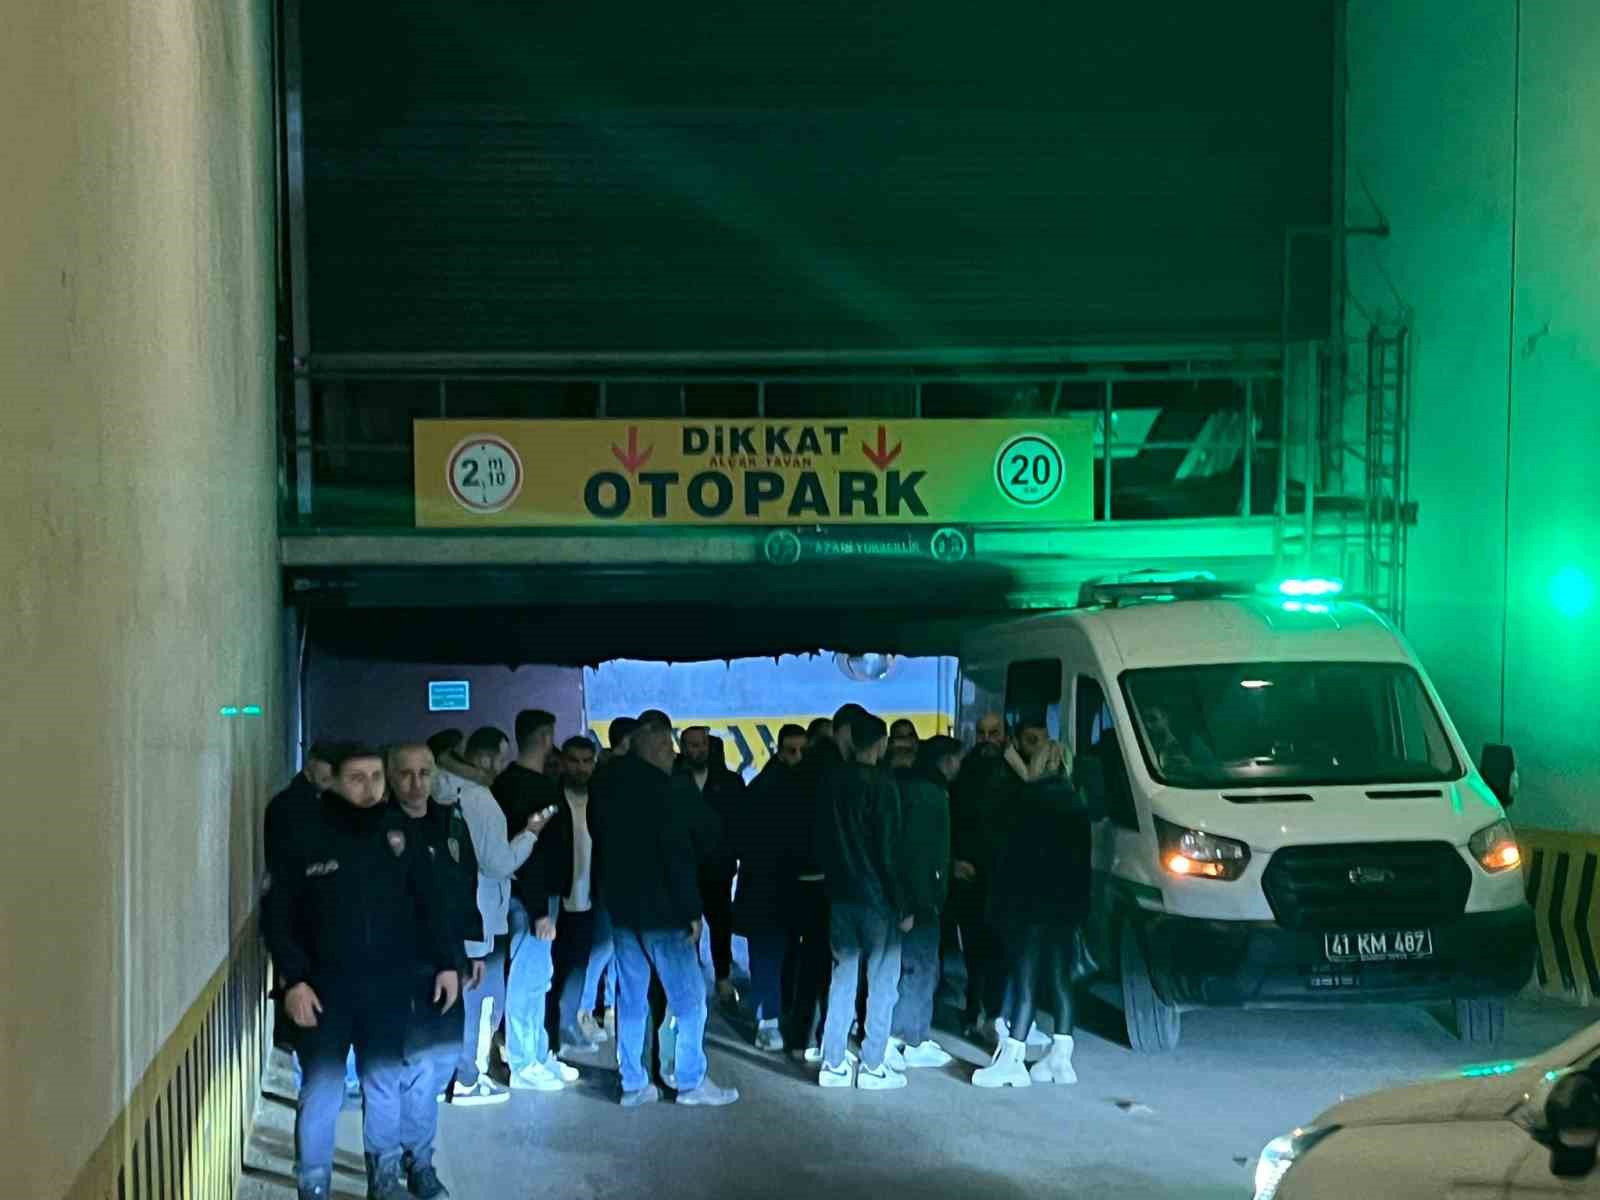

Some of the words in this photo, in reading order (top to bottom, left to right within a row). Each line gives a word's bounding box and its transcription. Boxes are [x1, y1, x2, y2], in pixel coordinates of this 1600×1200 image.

[683, 425, 848, 456] DİKKAT
[461, 459, 480, 487] 2
[489, 471, 505, 486] 10
[766, 457, 812, 467] TAVAN
[1011, 454, 1050, 485] 20
[584, 471, 928, 518] OTOPARK
[1332, 933, 1349, 954] 41
[1358, 932, 1386, 954] KM
